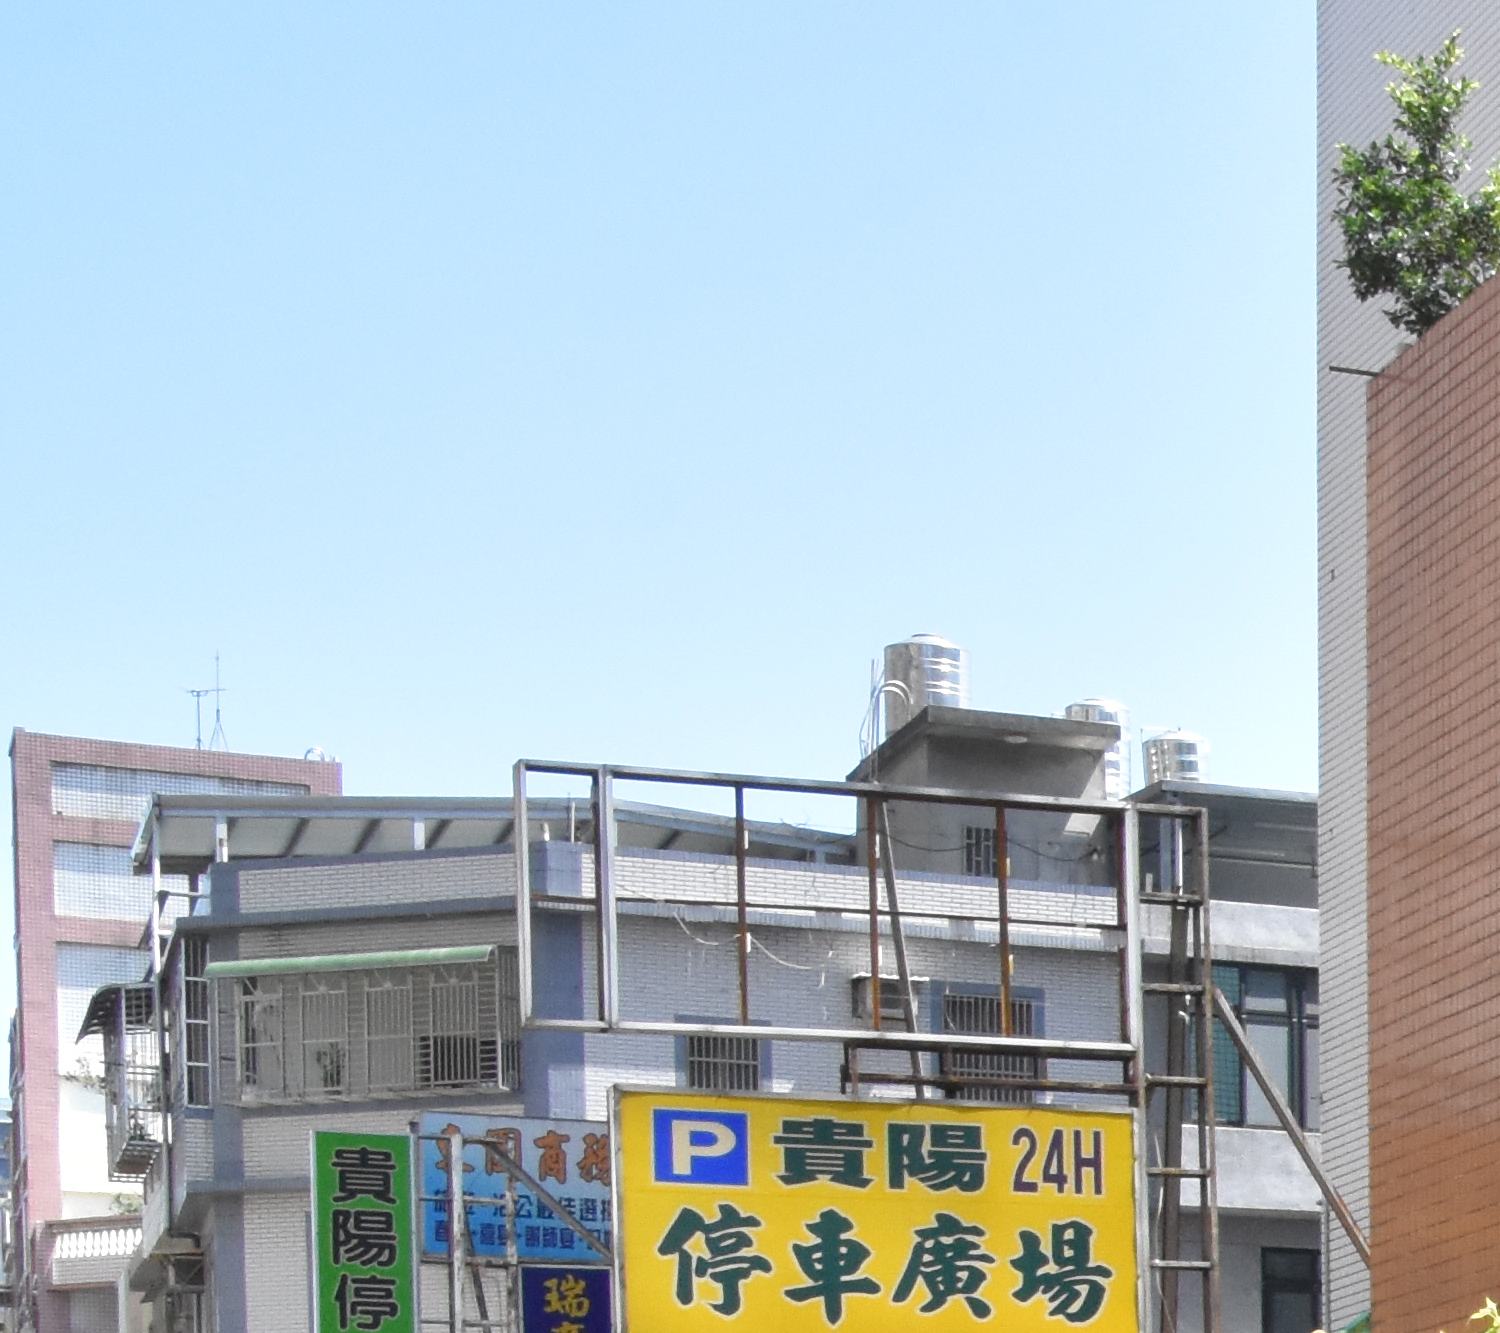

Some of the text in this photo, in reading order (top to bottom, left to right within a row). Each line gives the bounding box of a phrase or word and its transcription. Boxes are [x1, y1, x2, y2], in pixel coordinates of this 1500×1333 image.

[773, 1117, 988, 1193] 貴陽
[1011, 1126, 1103, 1196] 24H
[657, 1203, 1113, 1326] 停車廣場
